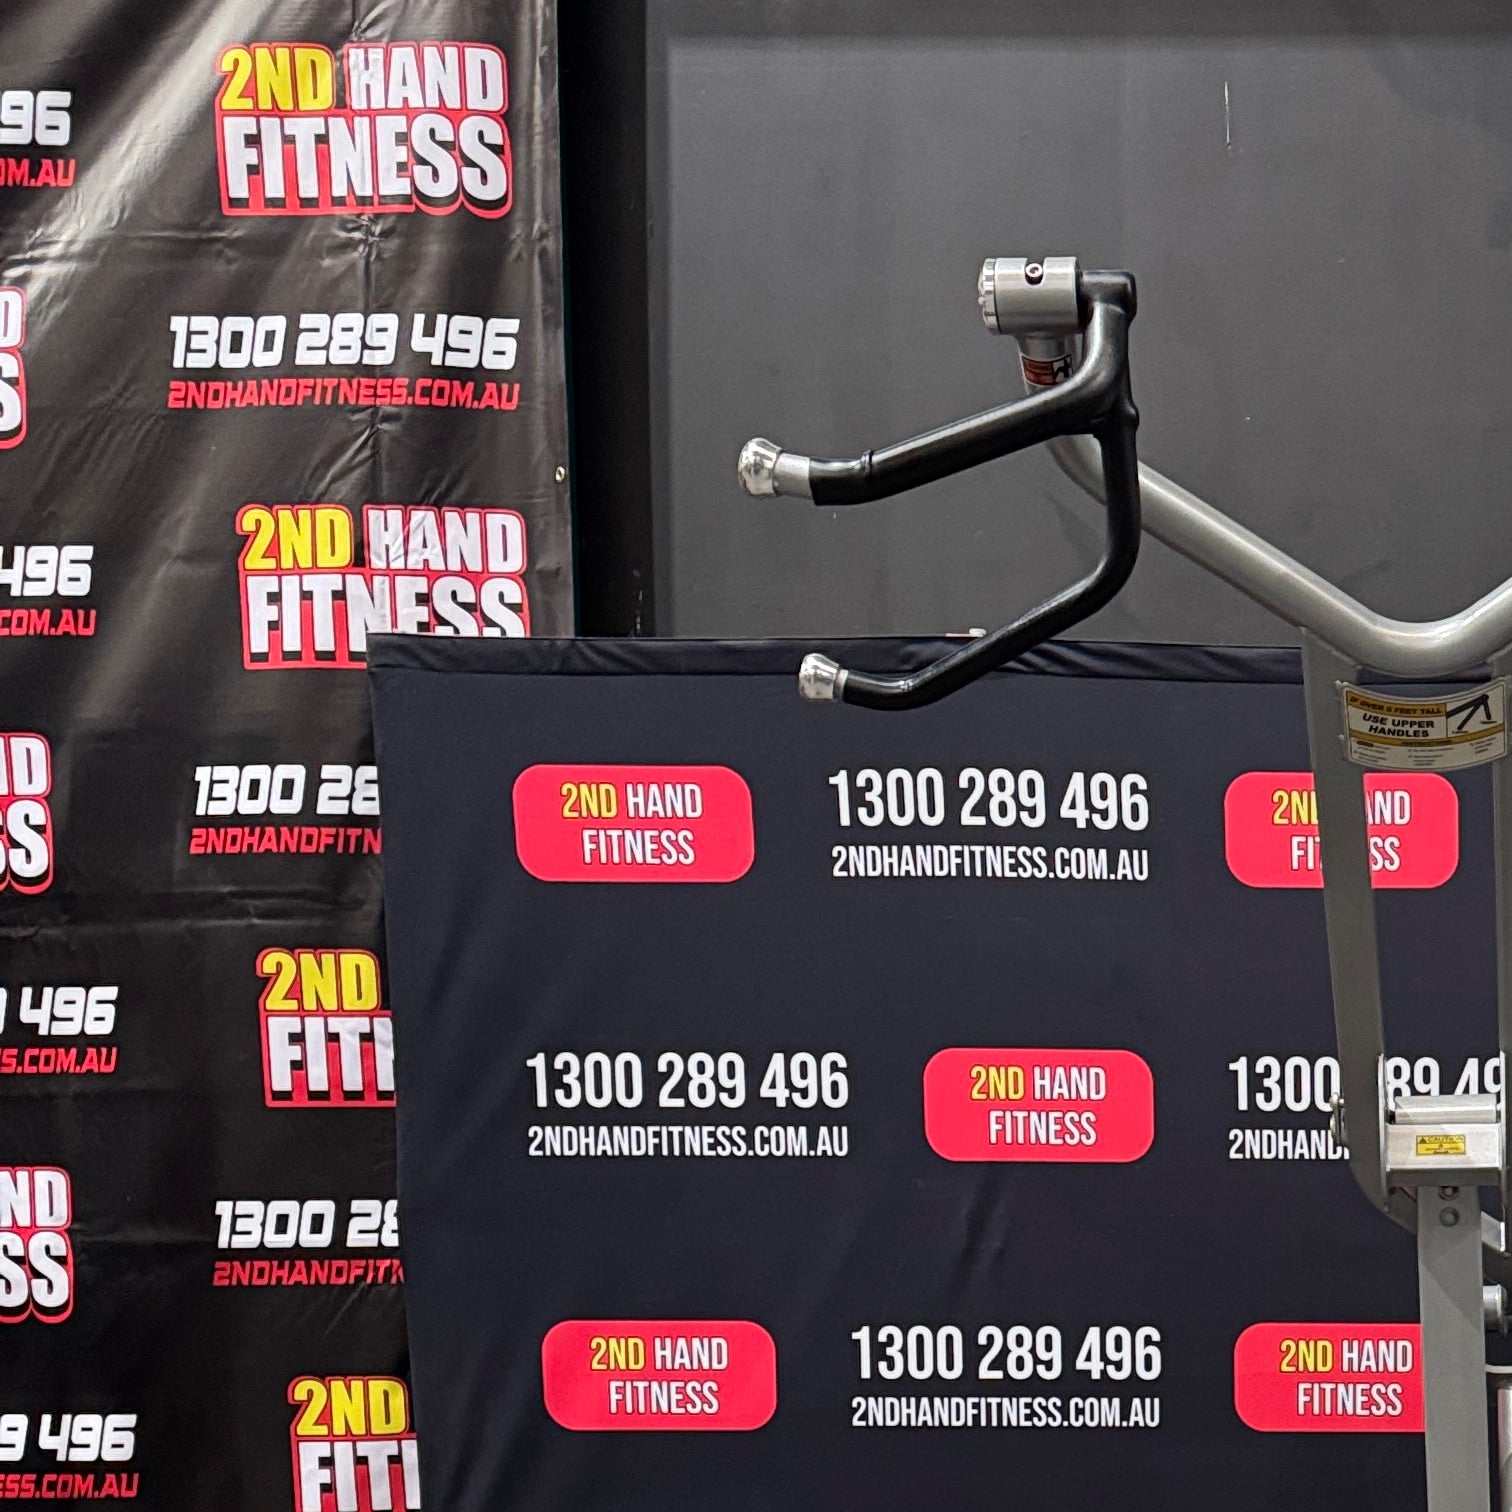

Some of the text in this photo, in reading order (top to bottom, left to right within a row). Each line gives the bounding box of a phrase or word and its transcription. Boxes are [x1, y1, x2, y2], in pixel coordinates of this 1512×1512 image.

[220, 45, 504, 112] 2ND HAND
[223, 114, 509, 202] FITNESS
[170, 313, 520, 370] 1300 289 496
[168, 377, 520, 410] 2NDHANDFITNESS.COM.AU
[242, 505, 526, 572] 2ND HAND
[0, 546, 93, 596] 496
[247, 574, 530, 653] FITNESS
[1362, 712, 1435, 729] USE UPPER
[1368, 724, 1430, 738] HANDLES
[1419, 707, 1442, 715] TALL
[195, 765, 306, 815] 1300
[562, 783, 702, 817] 2ND HAND
[829, 768, 1148, 830] 1300 289 496
[583, 830, 694, 864] FITNESS
[832, 845, 1148, 880] 2NDHANDFITNESS.COM.AU
[263, 952, 377, 1010] 2ND
[20, 986, 118, 1035] 496
[0, 1047, 117, 1073] S.COM.AU
[527, 1052, 848, 1108] 1300 289 496
[971, 1066, 1105, 1100] 2ND HAND
[1229, 1056, 1341, 1112] 1300
[529, 1126, 848, 1156] 2NDHANDFITNESS.COM.AU
[990, 1111, 1096, 1145] FITNESS
[215, 1200, 335, 1248] 1300
[591, 1338, 727, 1369] 2ND HAND
[852, 1326, 1161, 1380] 1300 289 496
[1281, 1340, 1412, 1372] 2ND HAND
[294, 1380, 405, 1435] 2ND
[610, 1381, 718, 1413] FITNESS
[852, 1397, 1159, 1427] 2NDHANDFITNESS.COM.AU
[1299, 1383, 1402, 1415] FITNESS
[39, 1414, 137, 1461] 496
